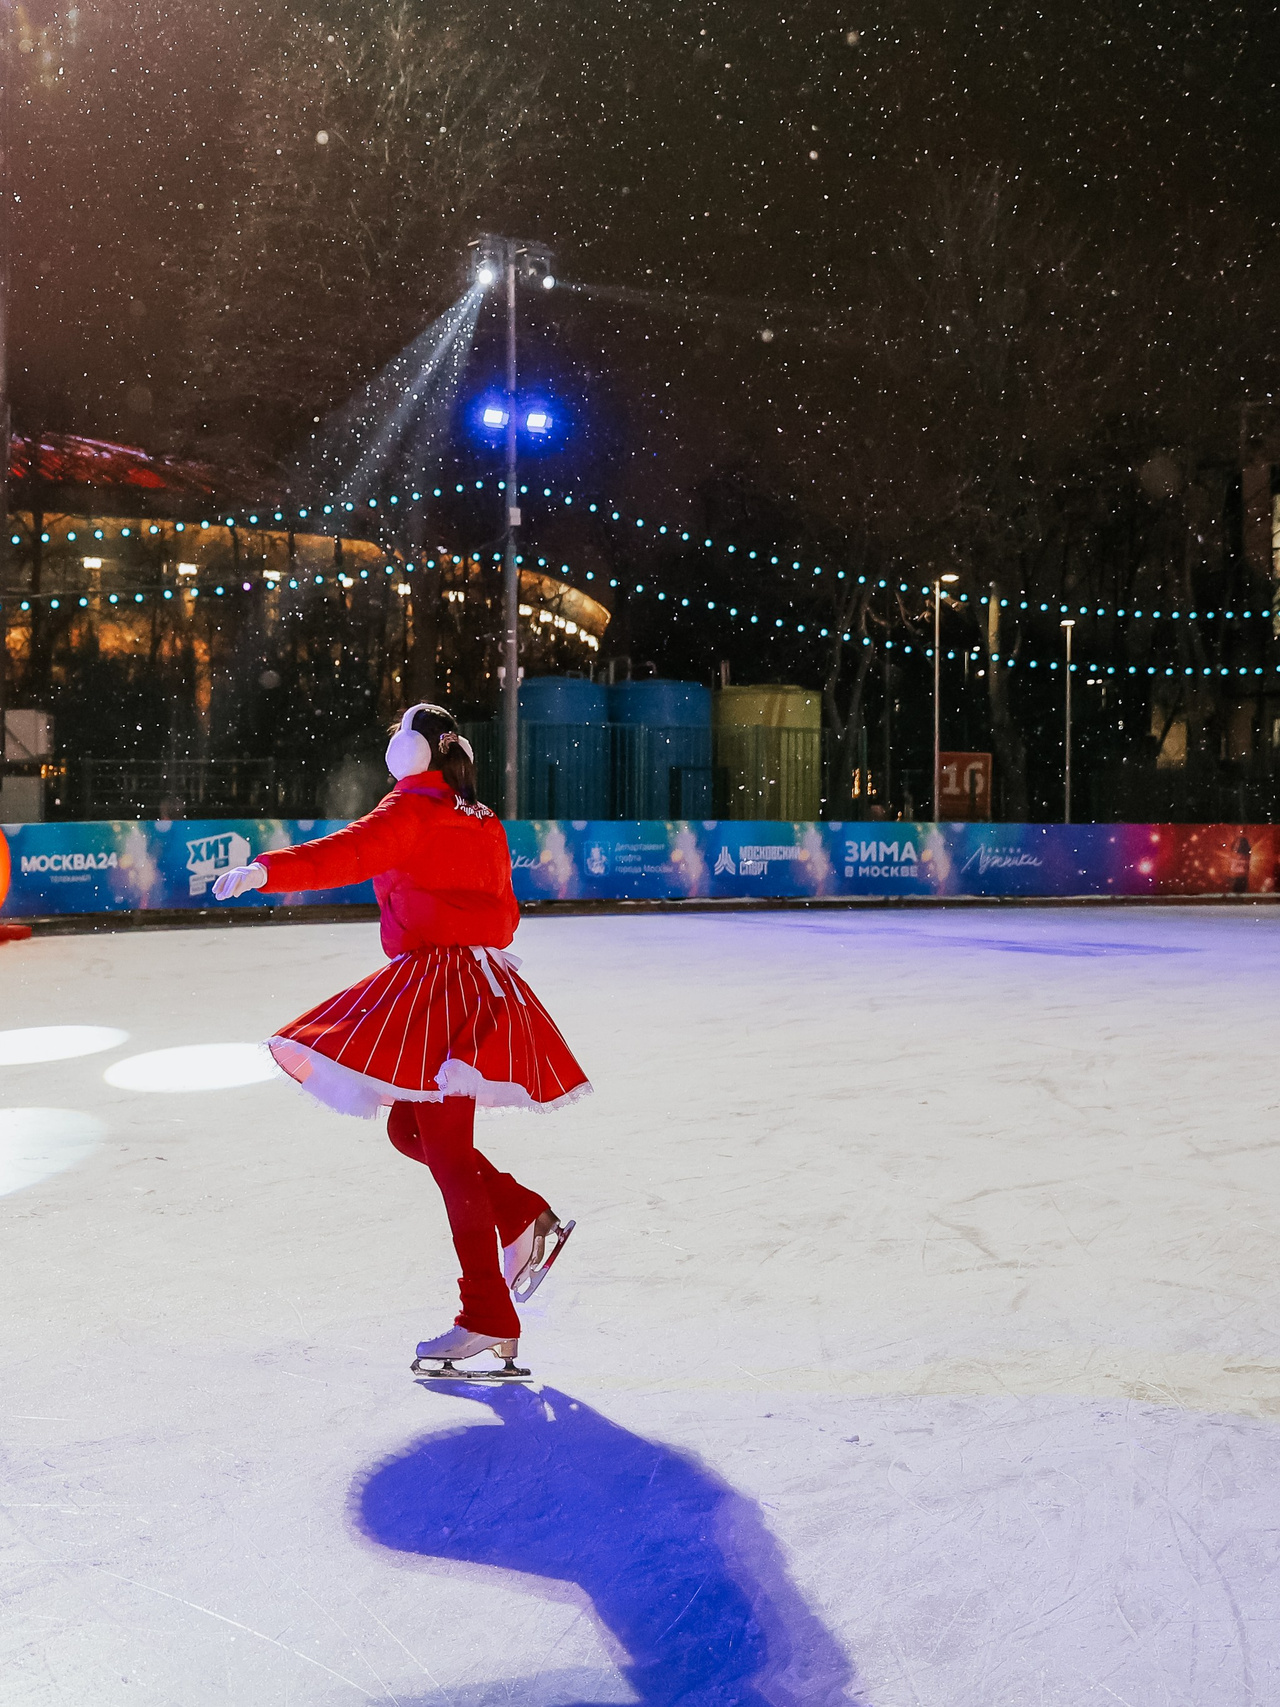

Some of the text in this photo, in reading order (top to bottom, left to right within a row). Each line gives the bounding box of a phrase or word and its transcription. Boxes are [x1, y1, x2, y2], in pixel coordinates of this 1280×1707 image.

[190, 835, 233, 864] ХИТ
[844, 841, 918, 863] ЗИМА
[858, 865, 918, 877] МОСКВЕ
